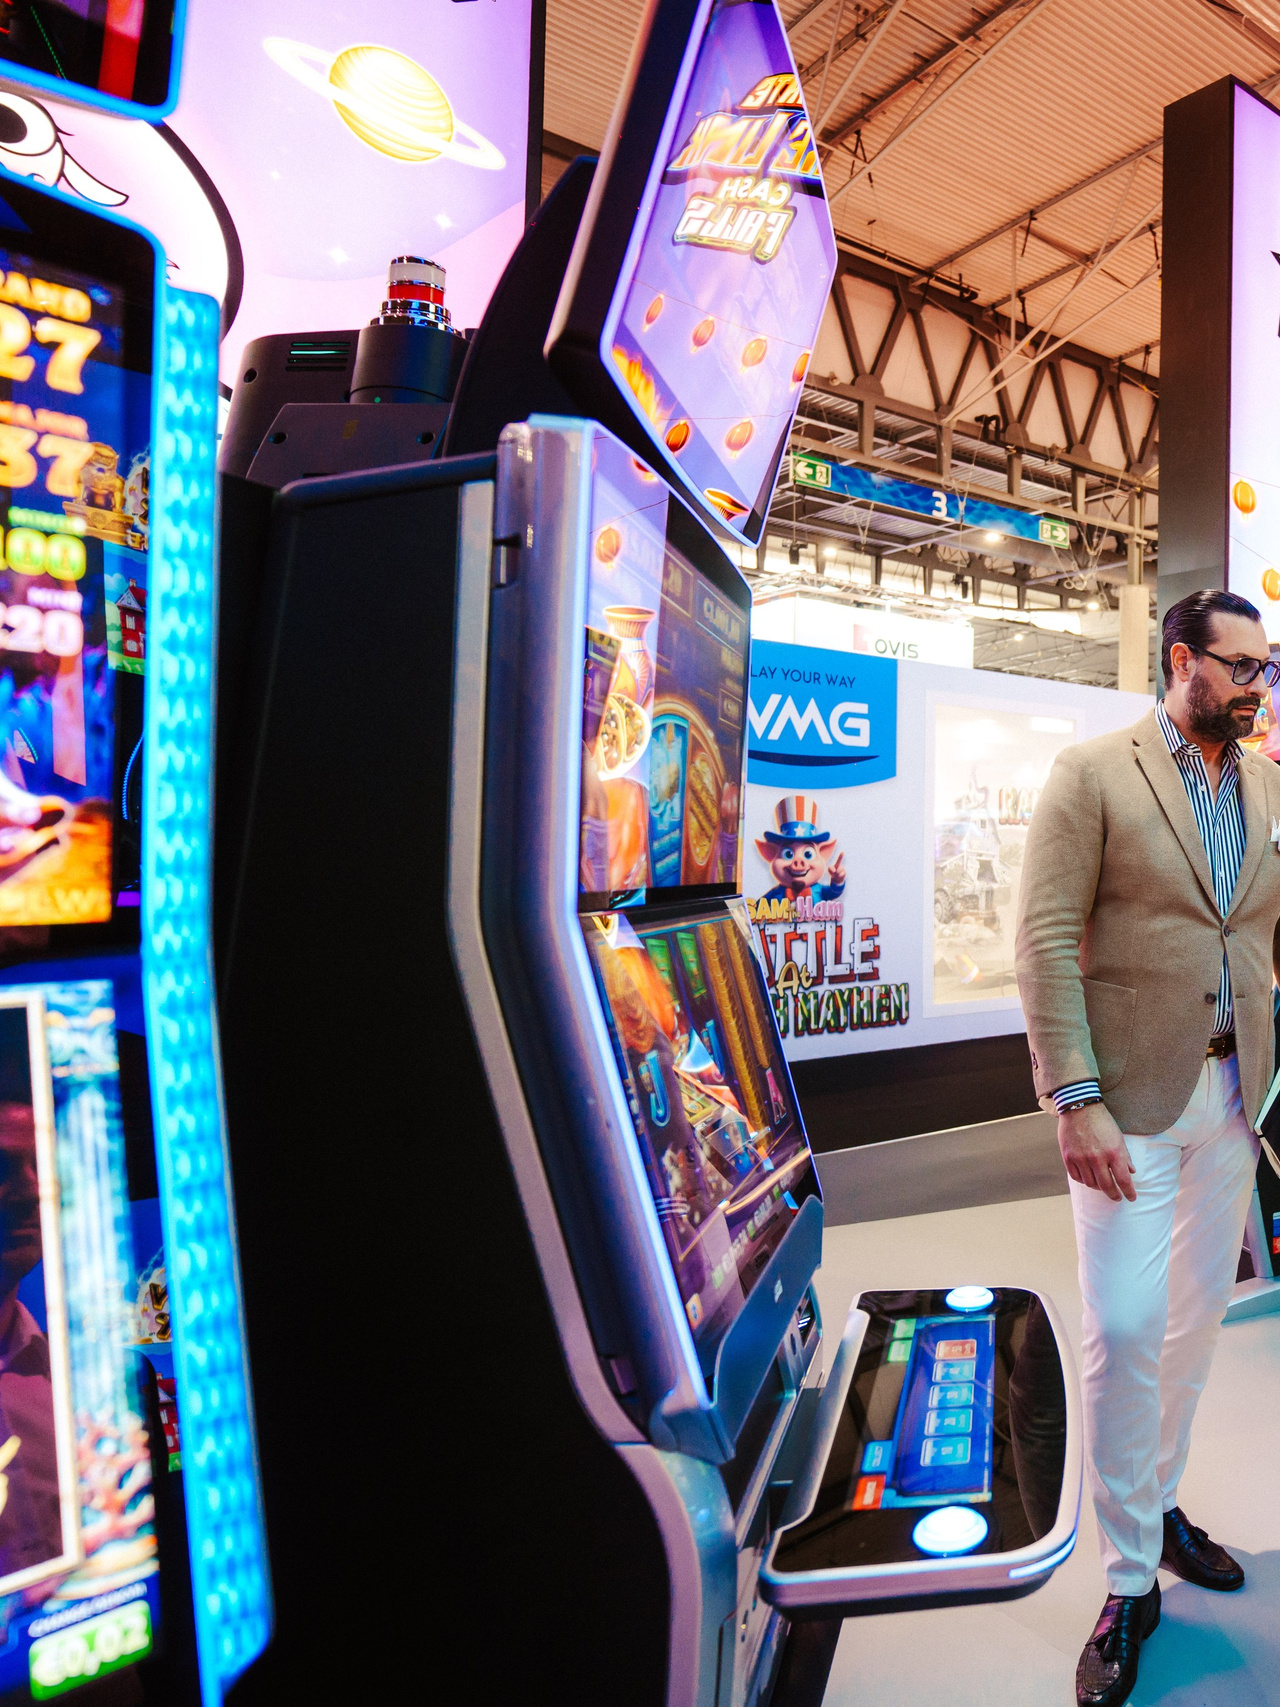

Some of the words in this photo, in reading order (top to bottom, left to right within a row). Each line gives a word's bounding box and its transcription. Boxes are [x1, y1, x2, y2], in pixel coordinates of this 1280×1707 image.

[932, 491, 948, 518] 3
[781, 667, 822, 686] YOUR
[825, 673, 857, 689] WAY
[796, 895, 843, 922] Ham
[776, 961, 814, 997] At
